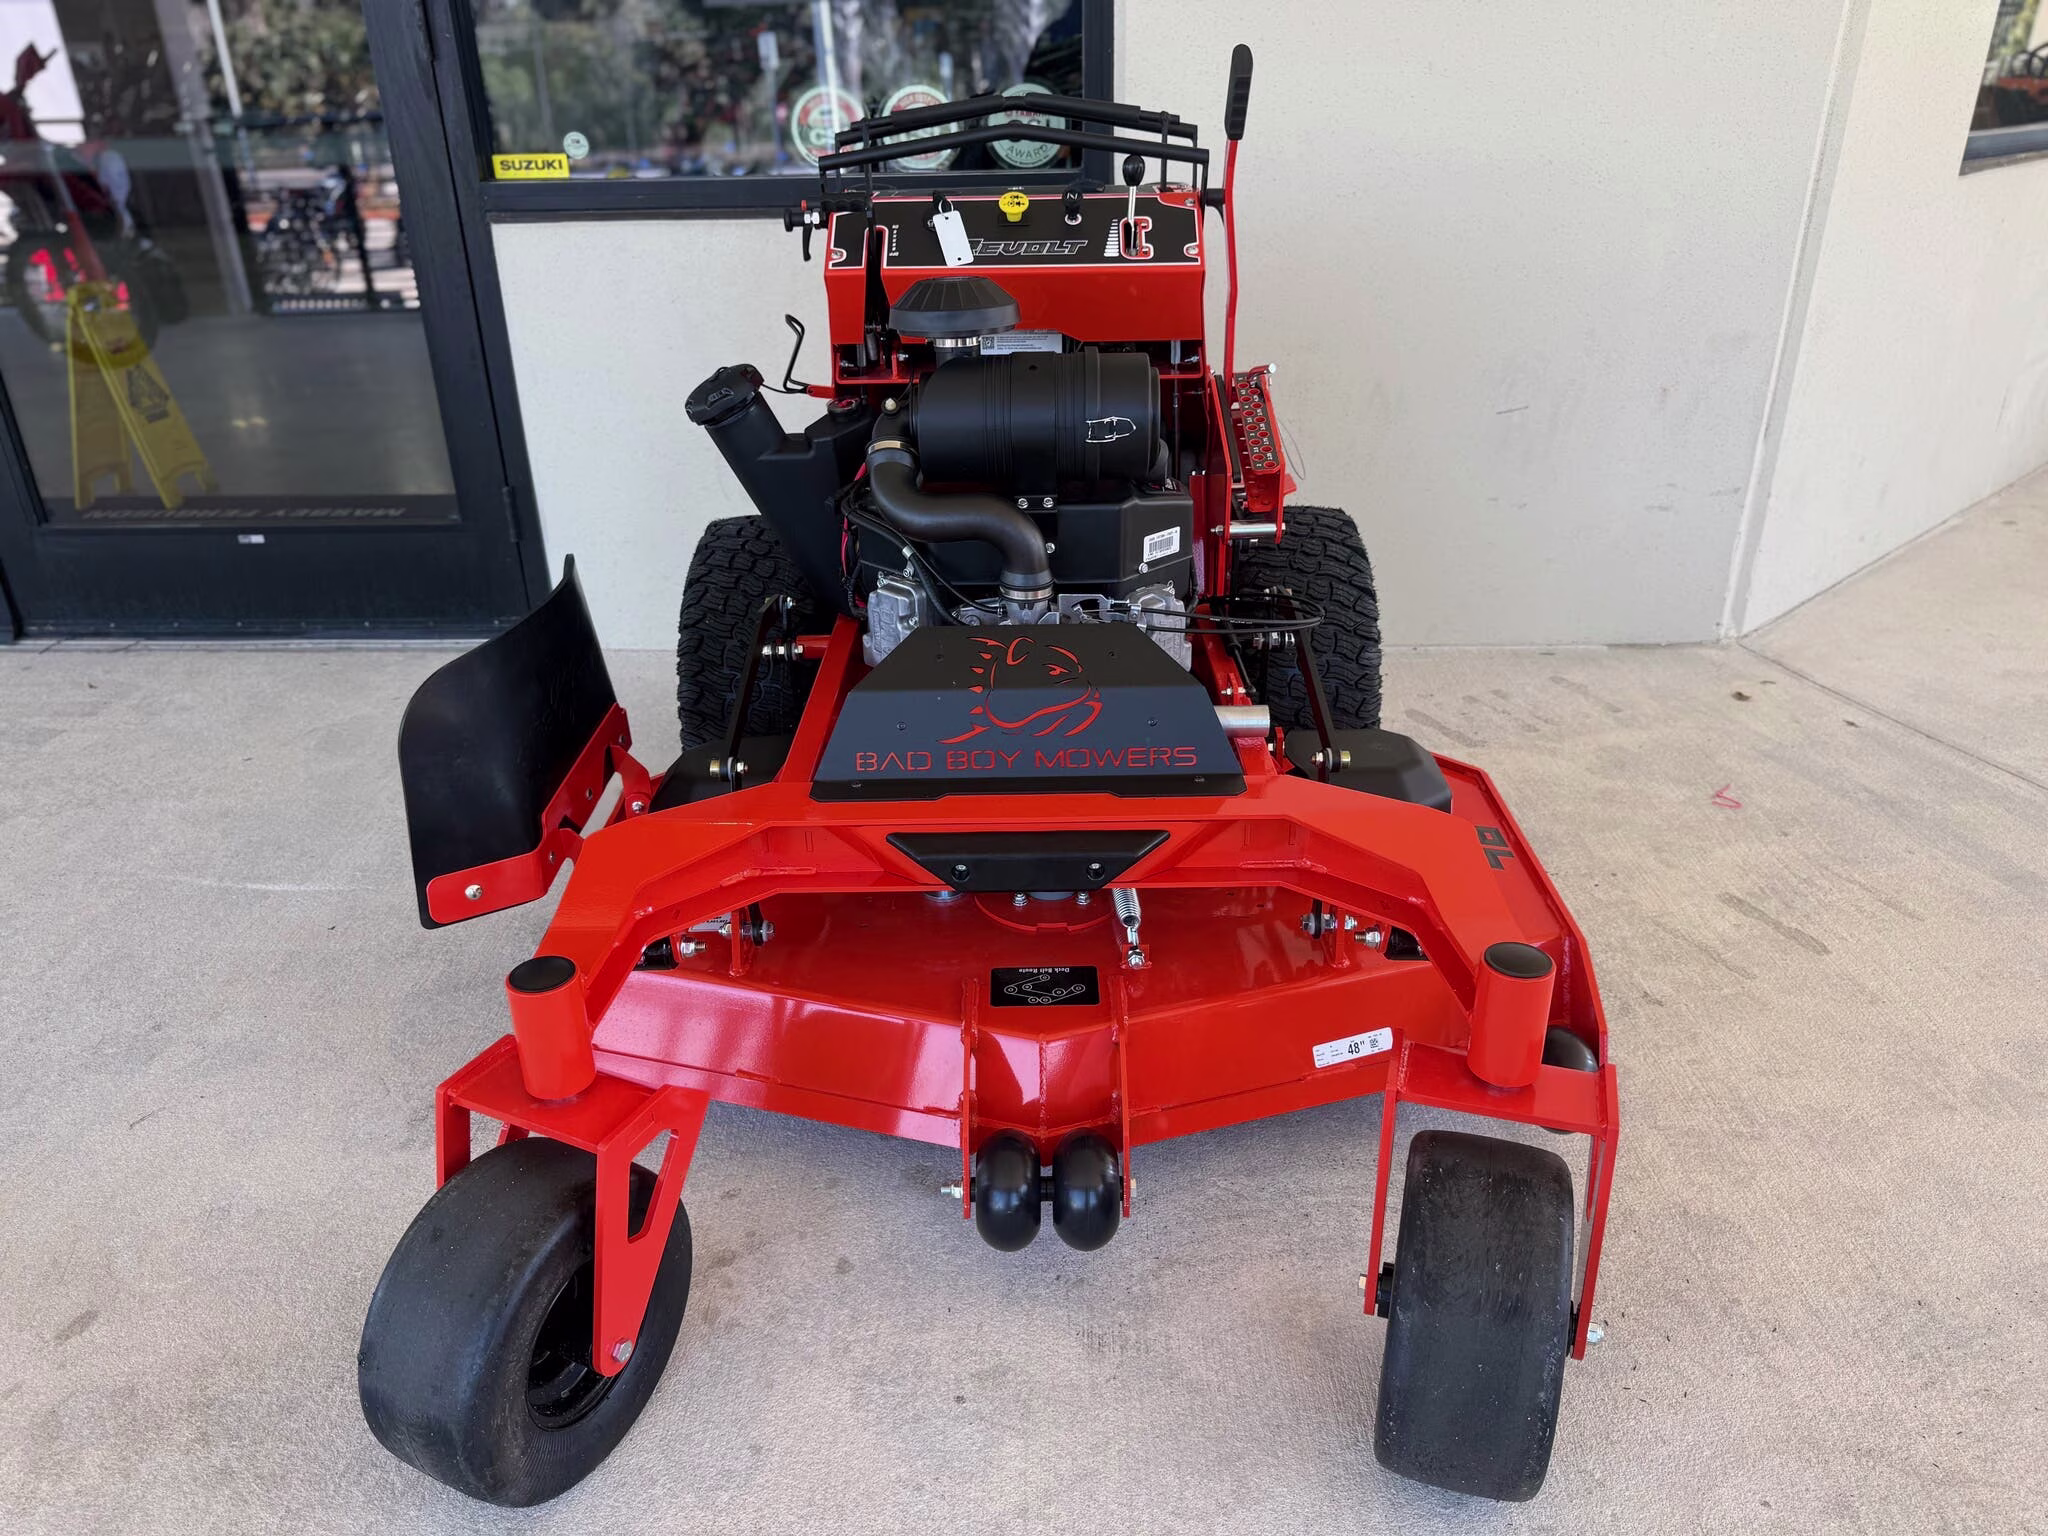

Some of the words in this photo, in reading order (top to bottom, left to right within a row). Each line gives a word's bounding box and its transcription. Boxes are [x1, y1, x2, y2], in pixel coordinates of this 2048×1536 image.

[1007, 144, 1048, 159] AWARD
[500, 160, 563, 171] SUZUKI
[855, 751, 932, 771] BAD
[946, 749, 1022, 770] BOY
[1034, 746, 1198, 769] MOWERS
[1347, 1040, 1365, 1055] 48"
